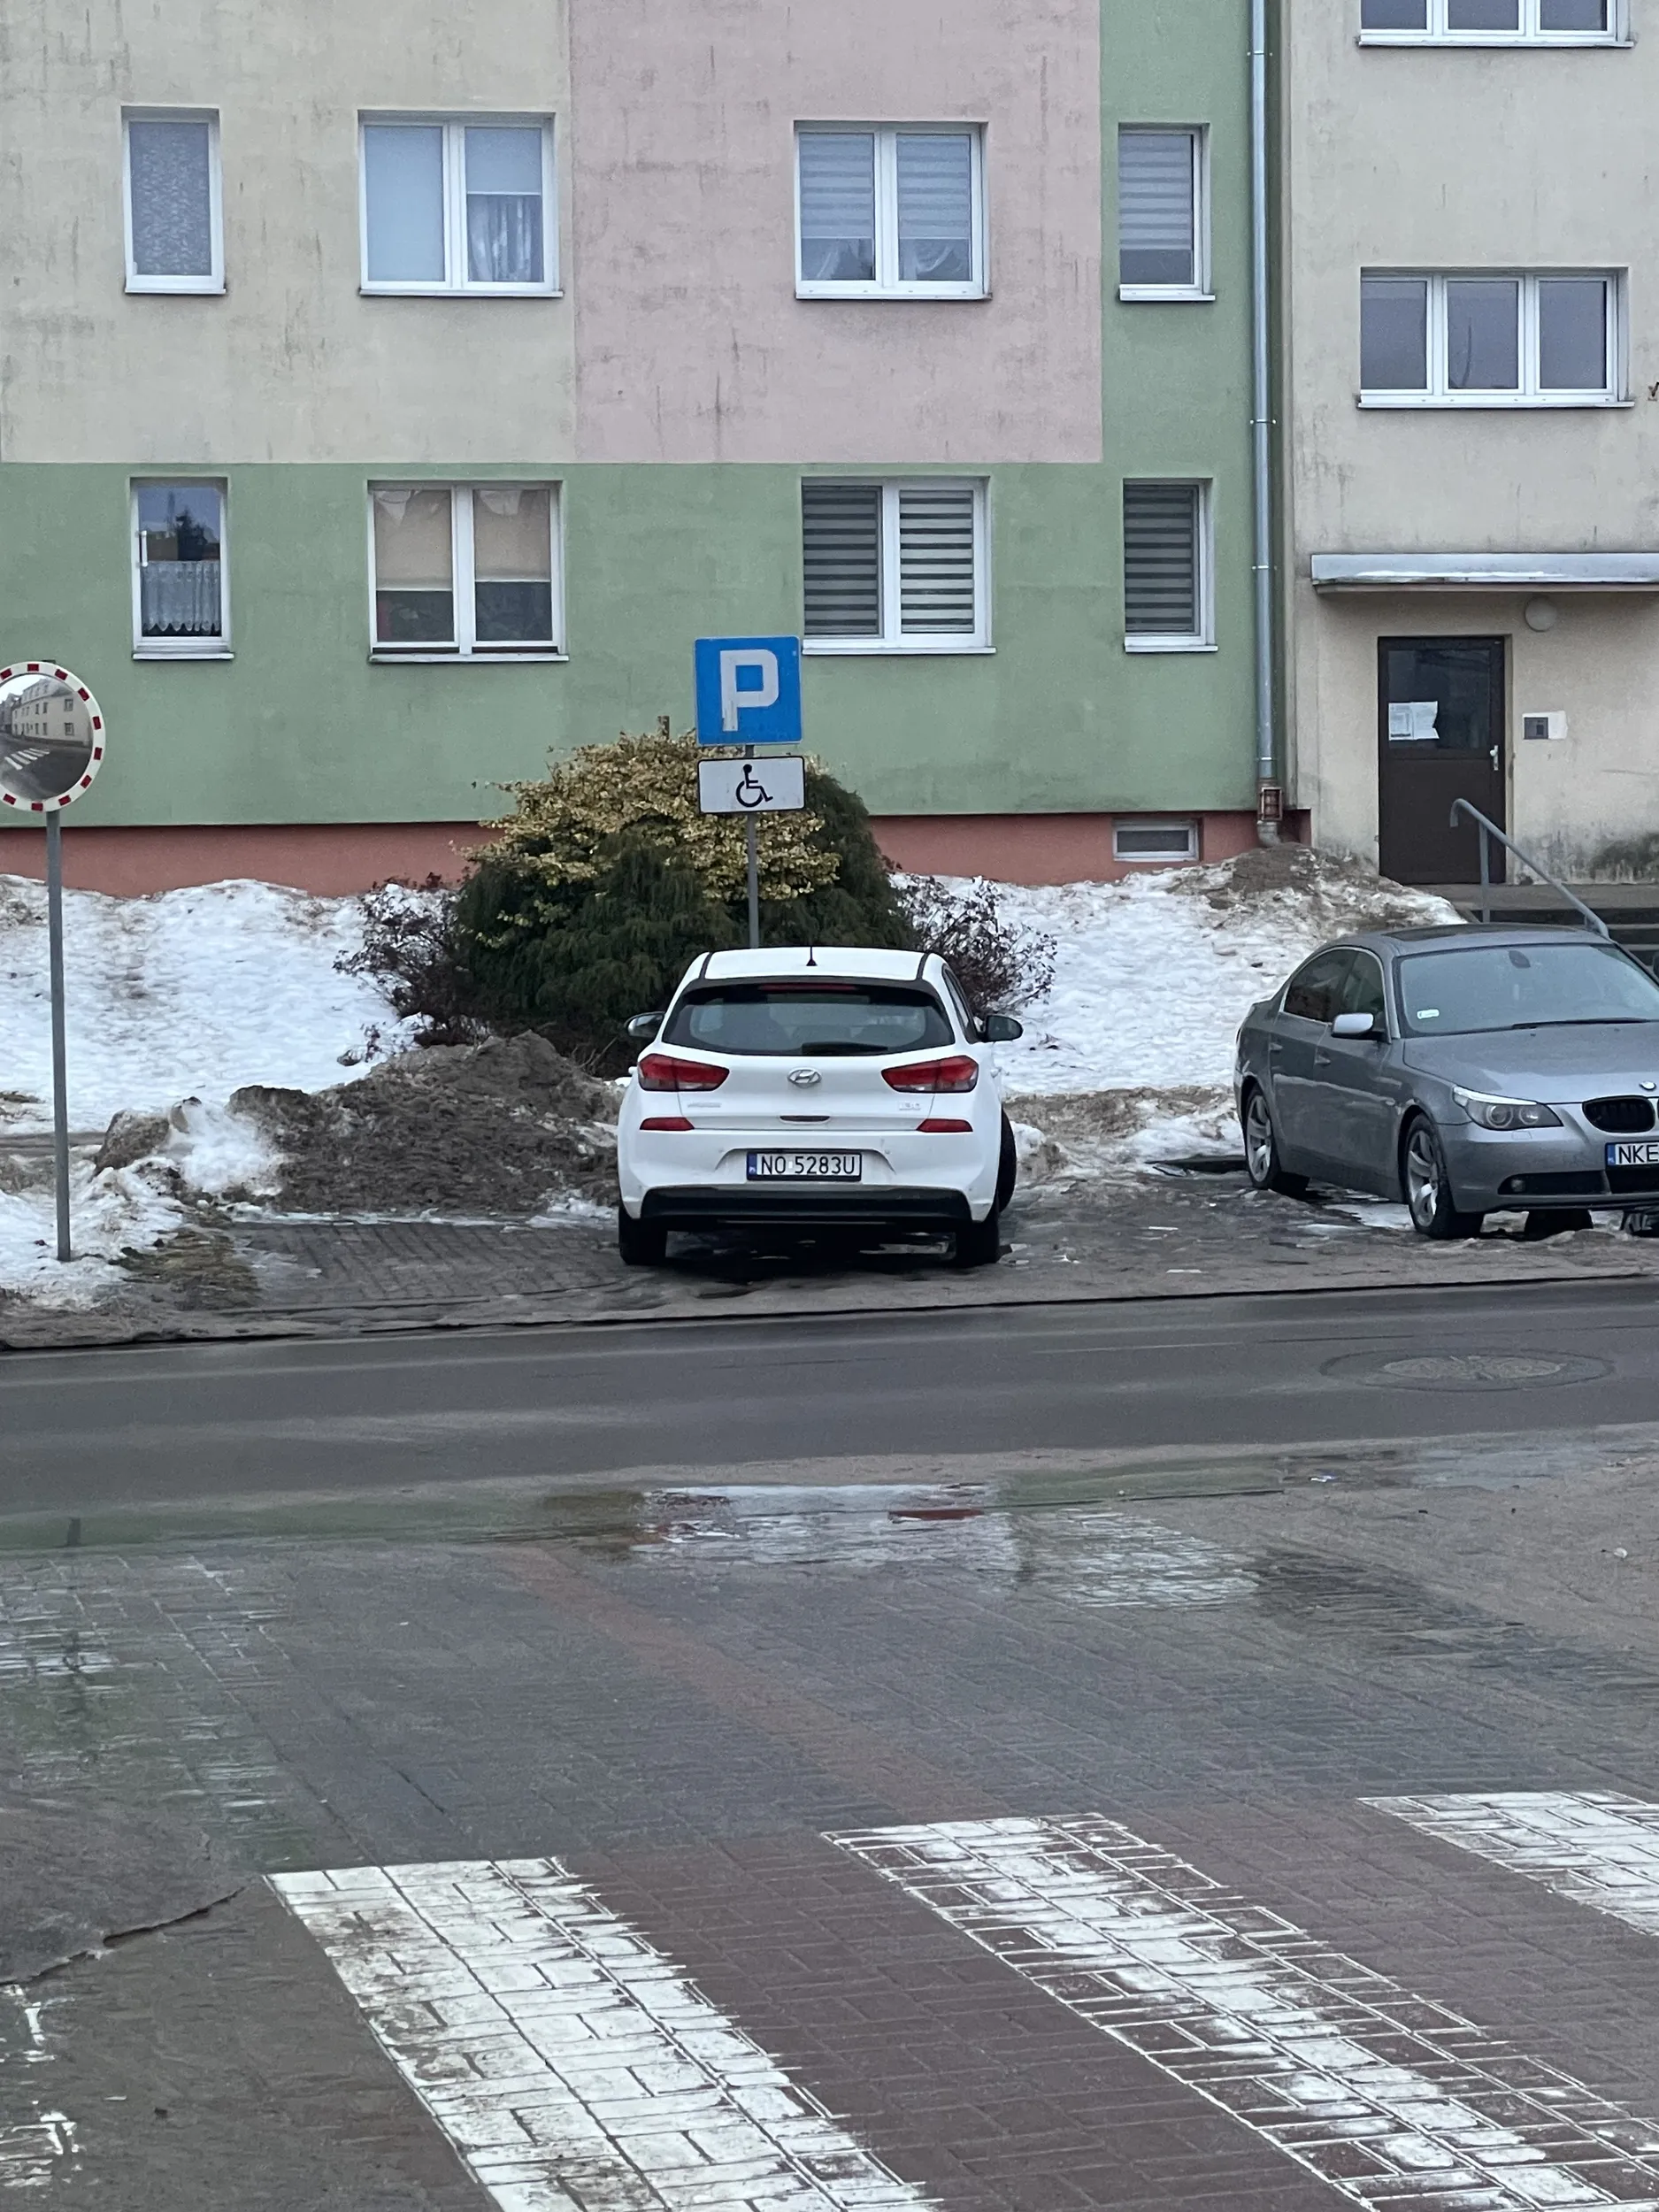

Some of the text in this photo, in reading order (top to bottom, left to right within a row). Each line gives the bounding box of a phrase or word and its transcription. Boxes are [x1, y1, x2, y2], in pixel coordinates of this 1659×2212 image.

[719, 649, 780, 732] P
[1618, 1144, 1659, 1164] NKE
[761, 1156, 787, 1175] NO
[795, 1156, 856, 1175] 5283U
